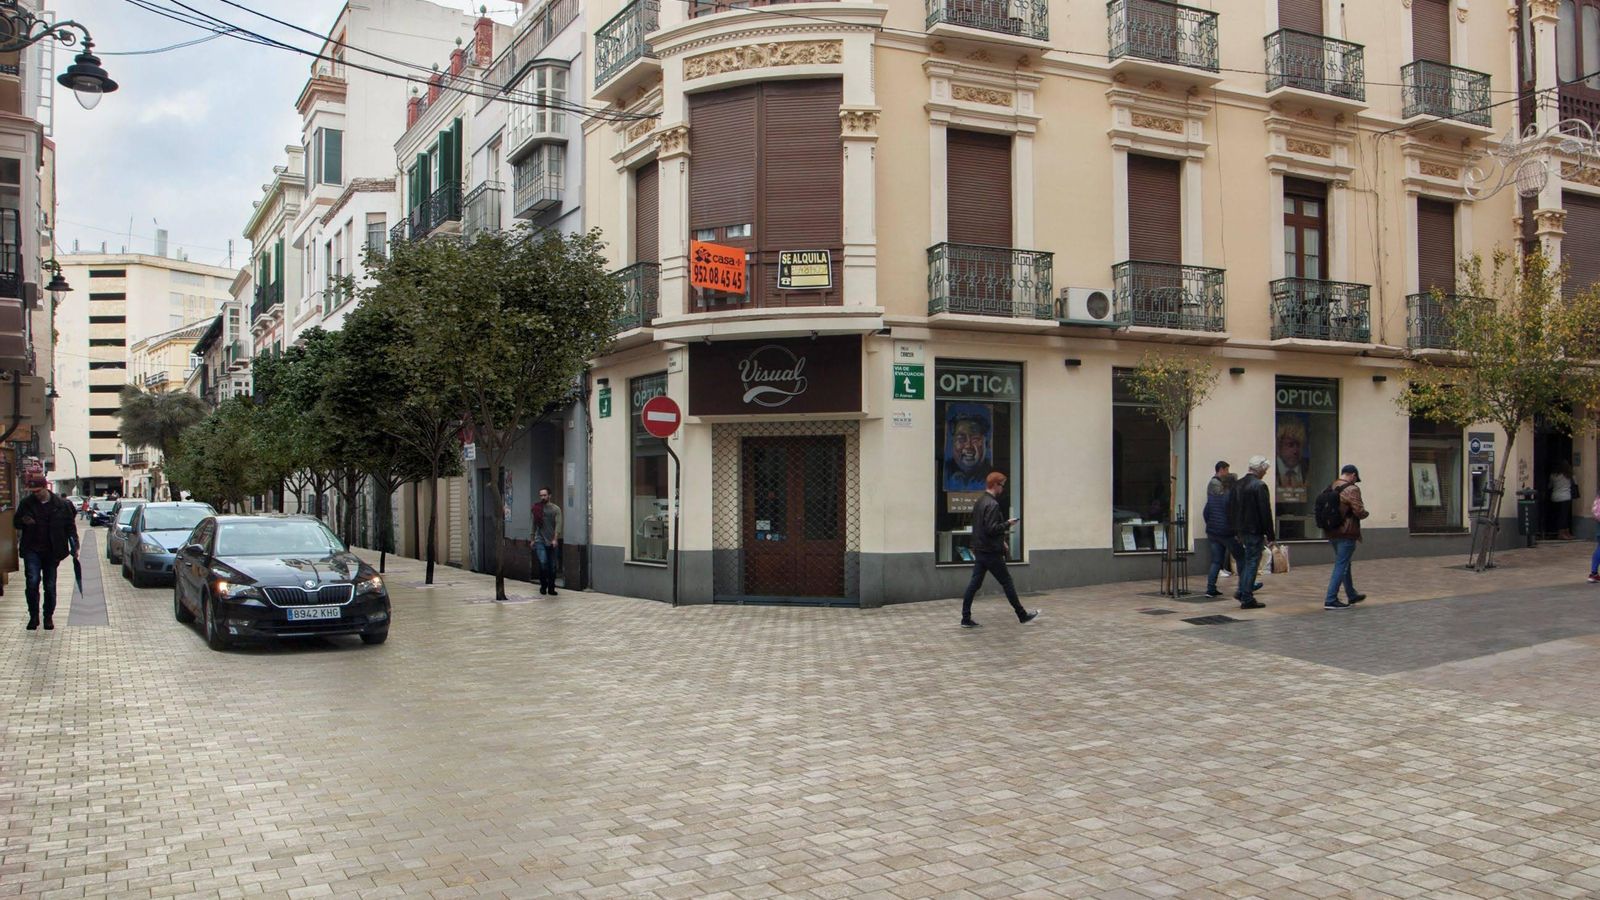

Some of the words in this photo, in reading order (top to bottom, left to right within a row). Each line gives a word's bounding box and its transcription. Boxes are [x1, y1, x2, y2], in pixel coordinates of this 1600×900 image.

[782, 253, 791, 264] SE
[792, 252, 827, 264] ALQUILA
[694, 265, 707, 283] 952
[709, 267, 719, 284] 08
[721, 269, 730, 288] 45
[732, 271, 742, 290] 45
[738, 356, 807, 393] Visual
[940, 374, 1015, 394] OPTICA
[1277, 389, 1333, 406] OPTICA
[294, 610, 318, 618] 8942
[321, 608, 338, 617] KHG
